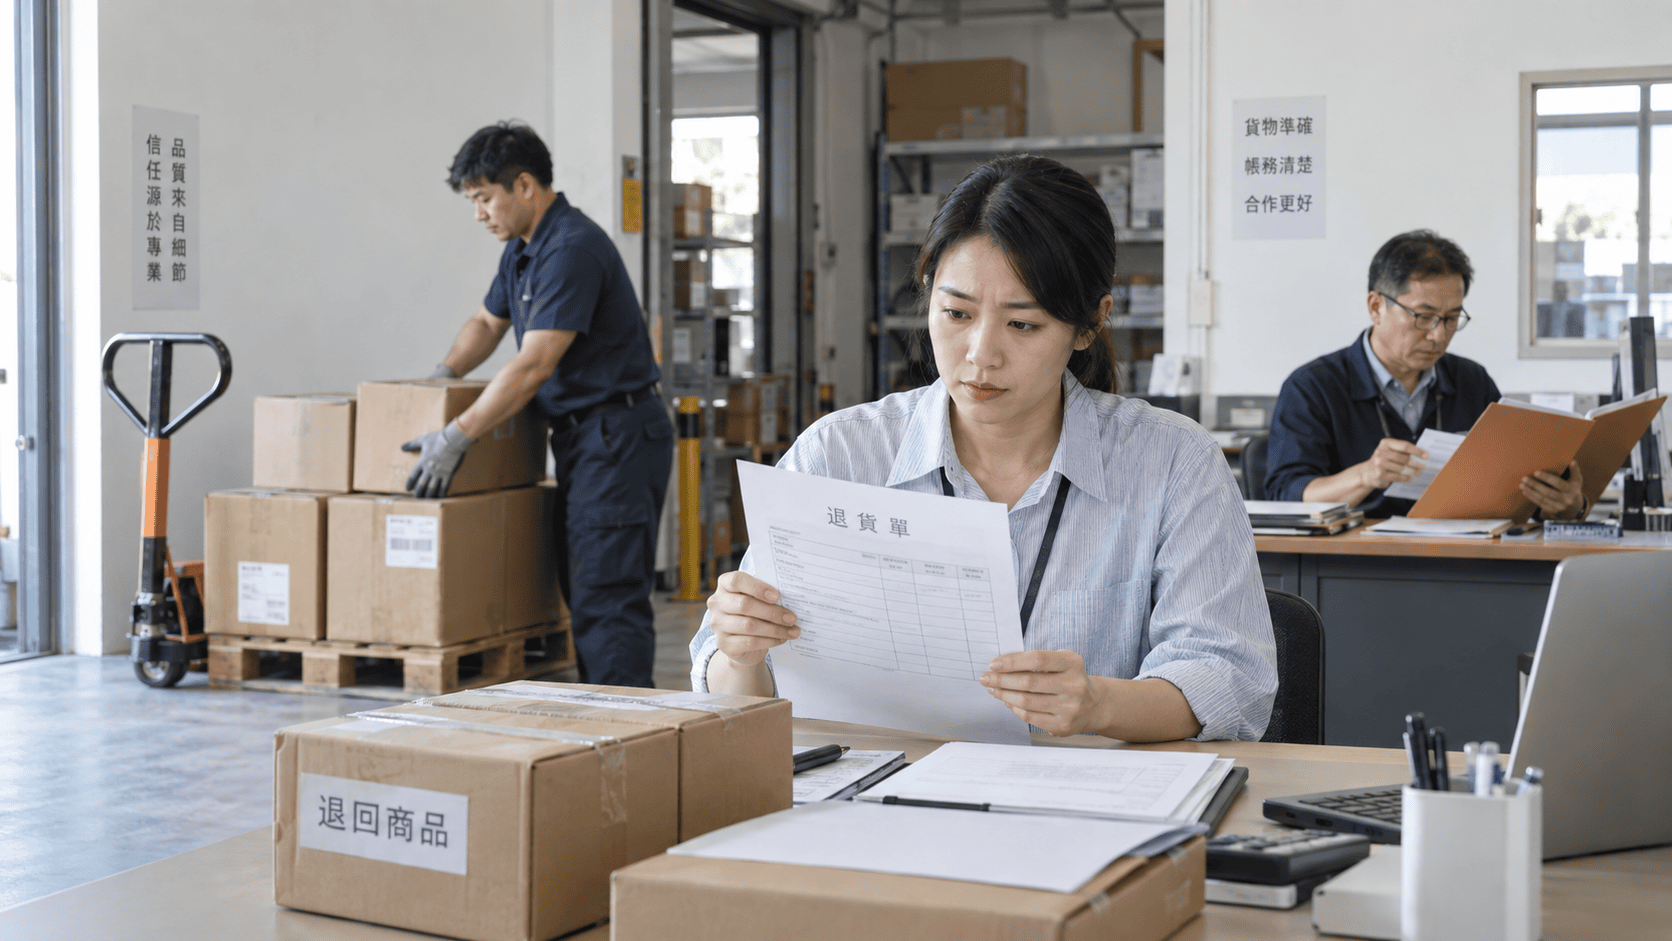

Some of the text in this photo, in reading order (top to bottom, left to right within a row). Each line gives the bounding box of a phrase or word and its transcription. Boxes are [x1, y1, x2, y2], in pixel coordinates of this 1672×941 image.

[1244, 116, 1313, 137] 貨物準確
[1244, 155, 1313, 176] 帳務清楚
[146, 133, 162, 282] 信任源於專業
[171, 138, 187, 282] 品質來自細節
[1244, 194, 1313, 213] 合作更好
[827, 506, 911, 538] 退貨單
[318, 795, 448, 848] 退回商品
